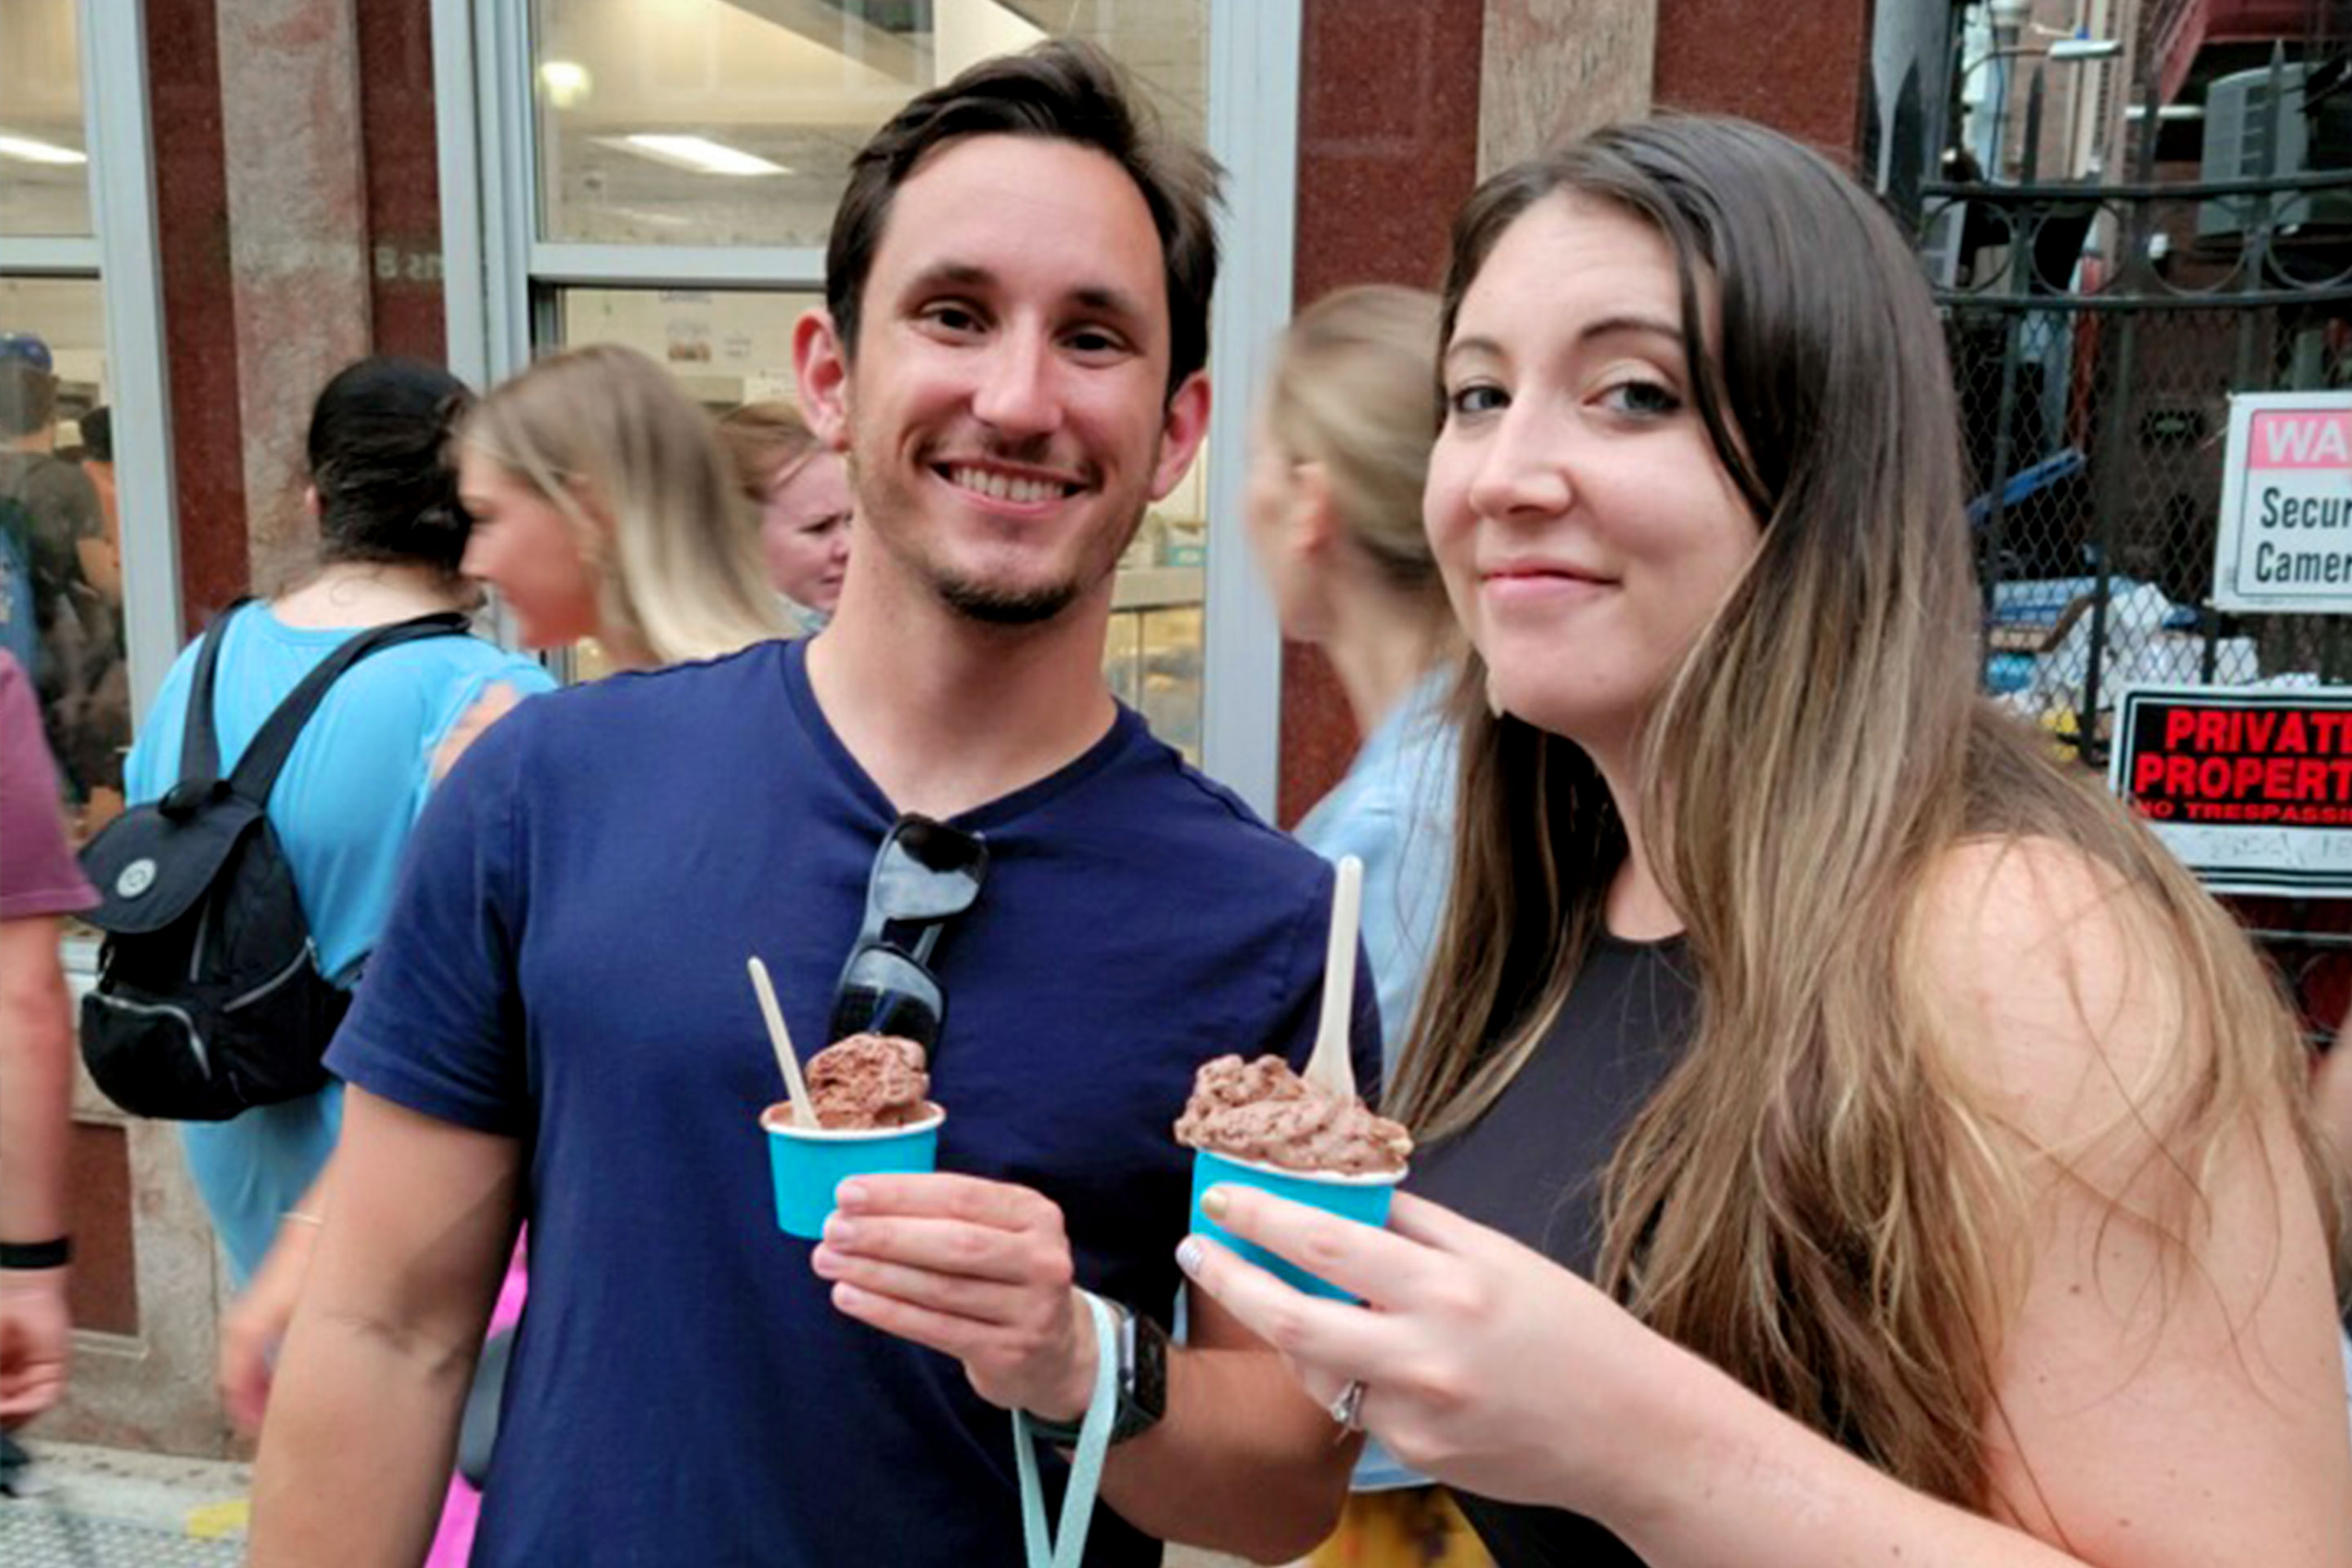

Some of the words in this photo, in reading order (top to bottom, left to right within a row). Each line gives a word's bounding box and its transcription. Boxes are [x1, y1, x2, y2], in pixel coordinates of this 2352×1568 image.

[2266, 420, 2349, 463] WA
[2261, 486, 2352, 529] Secur
[2256, 541, 2352, 583] Camer
